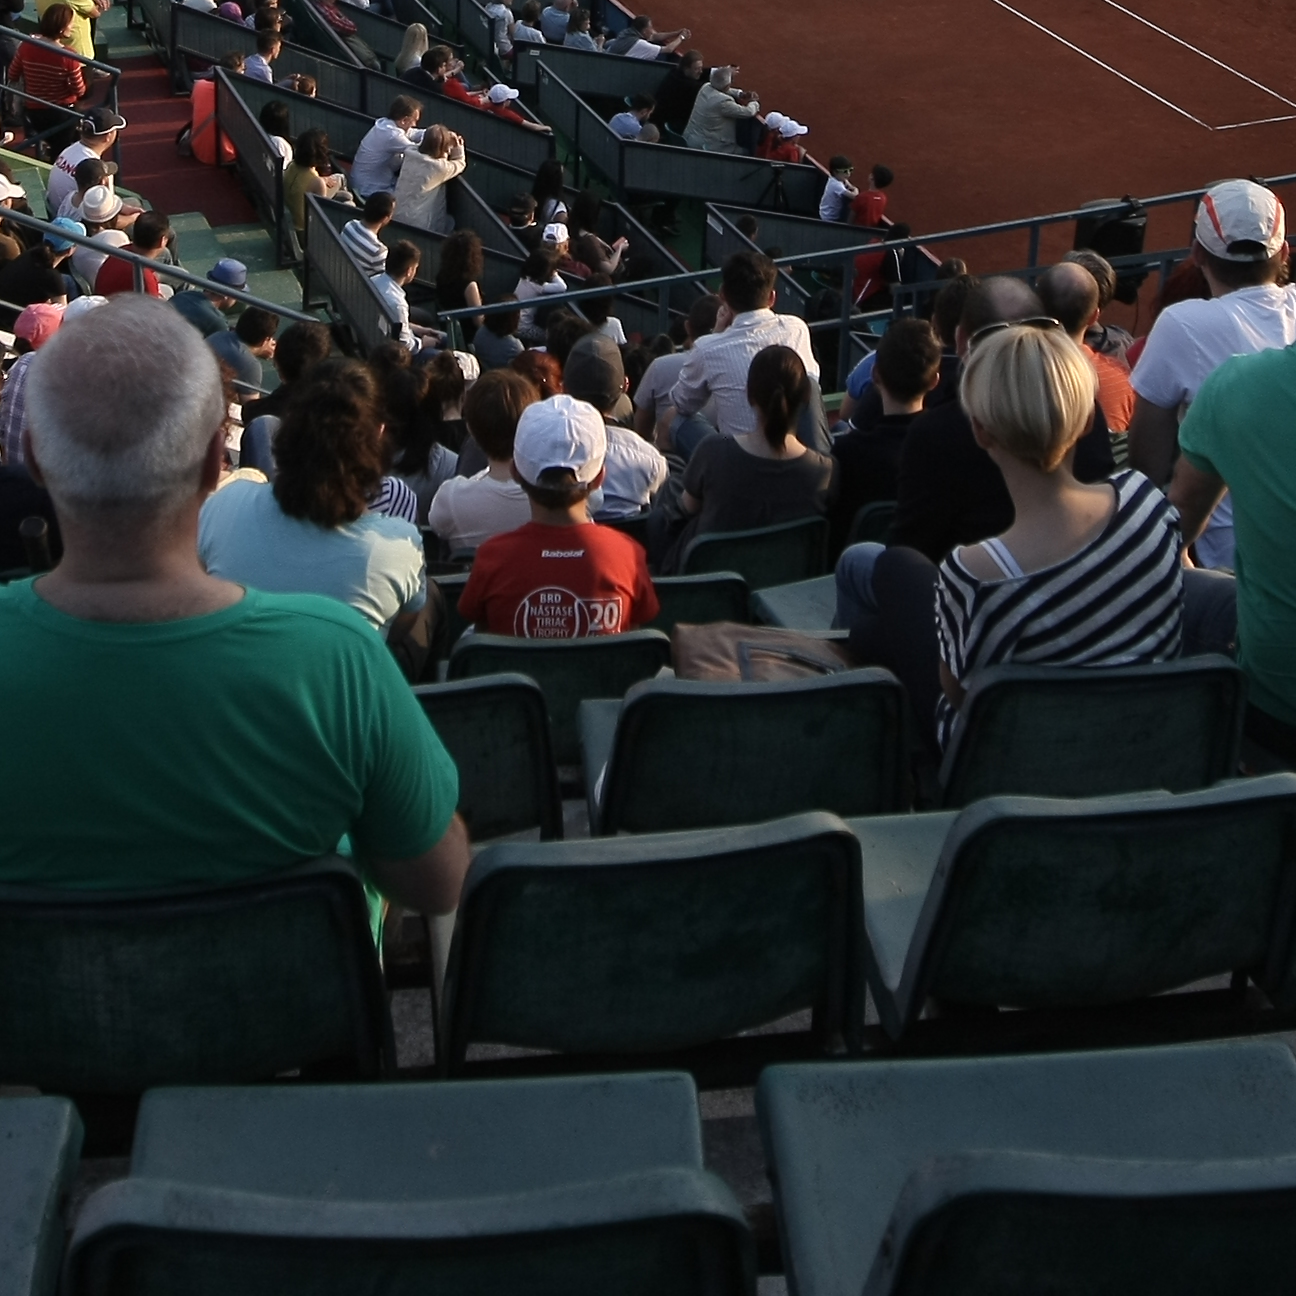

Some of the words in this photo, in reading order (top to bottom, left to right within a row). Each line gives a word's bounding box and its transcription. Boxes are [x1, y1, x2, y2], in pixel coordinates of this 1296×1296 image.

[541, 550, 585, 558] Babolat
[540, 594, 562, 604] BRD
[590, 602, 618, 631] 20
[536, 617, 566, 628] TIRIAC
[533, 628, 570, 638] TROPHY
